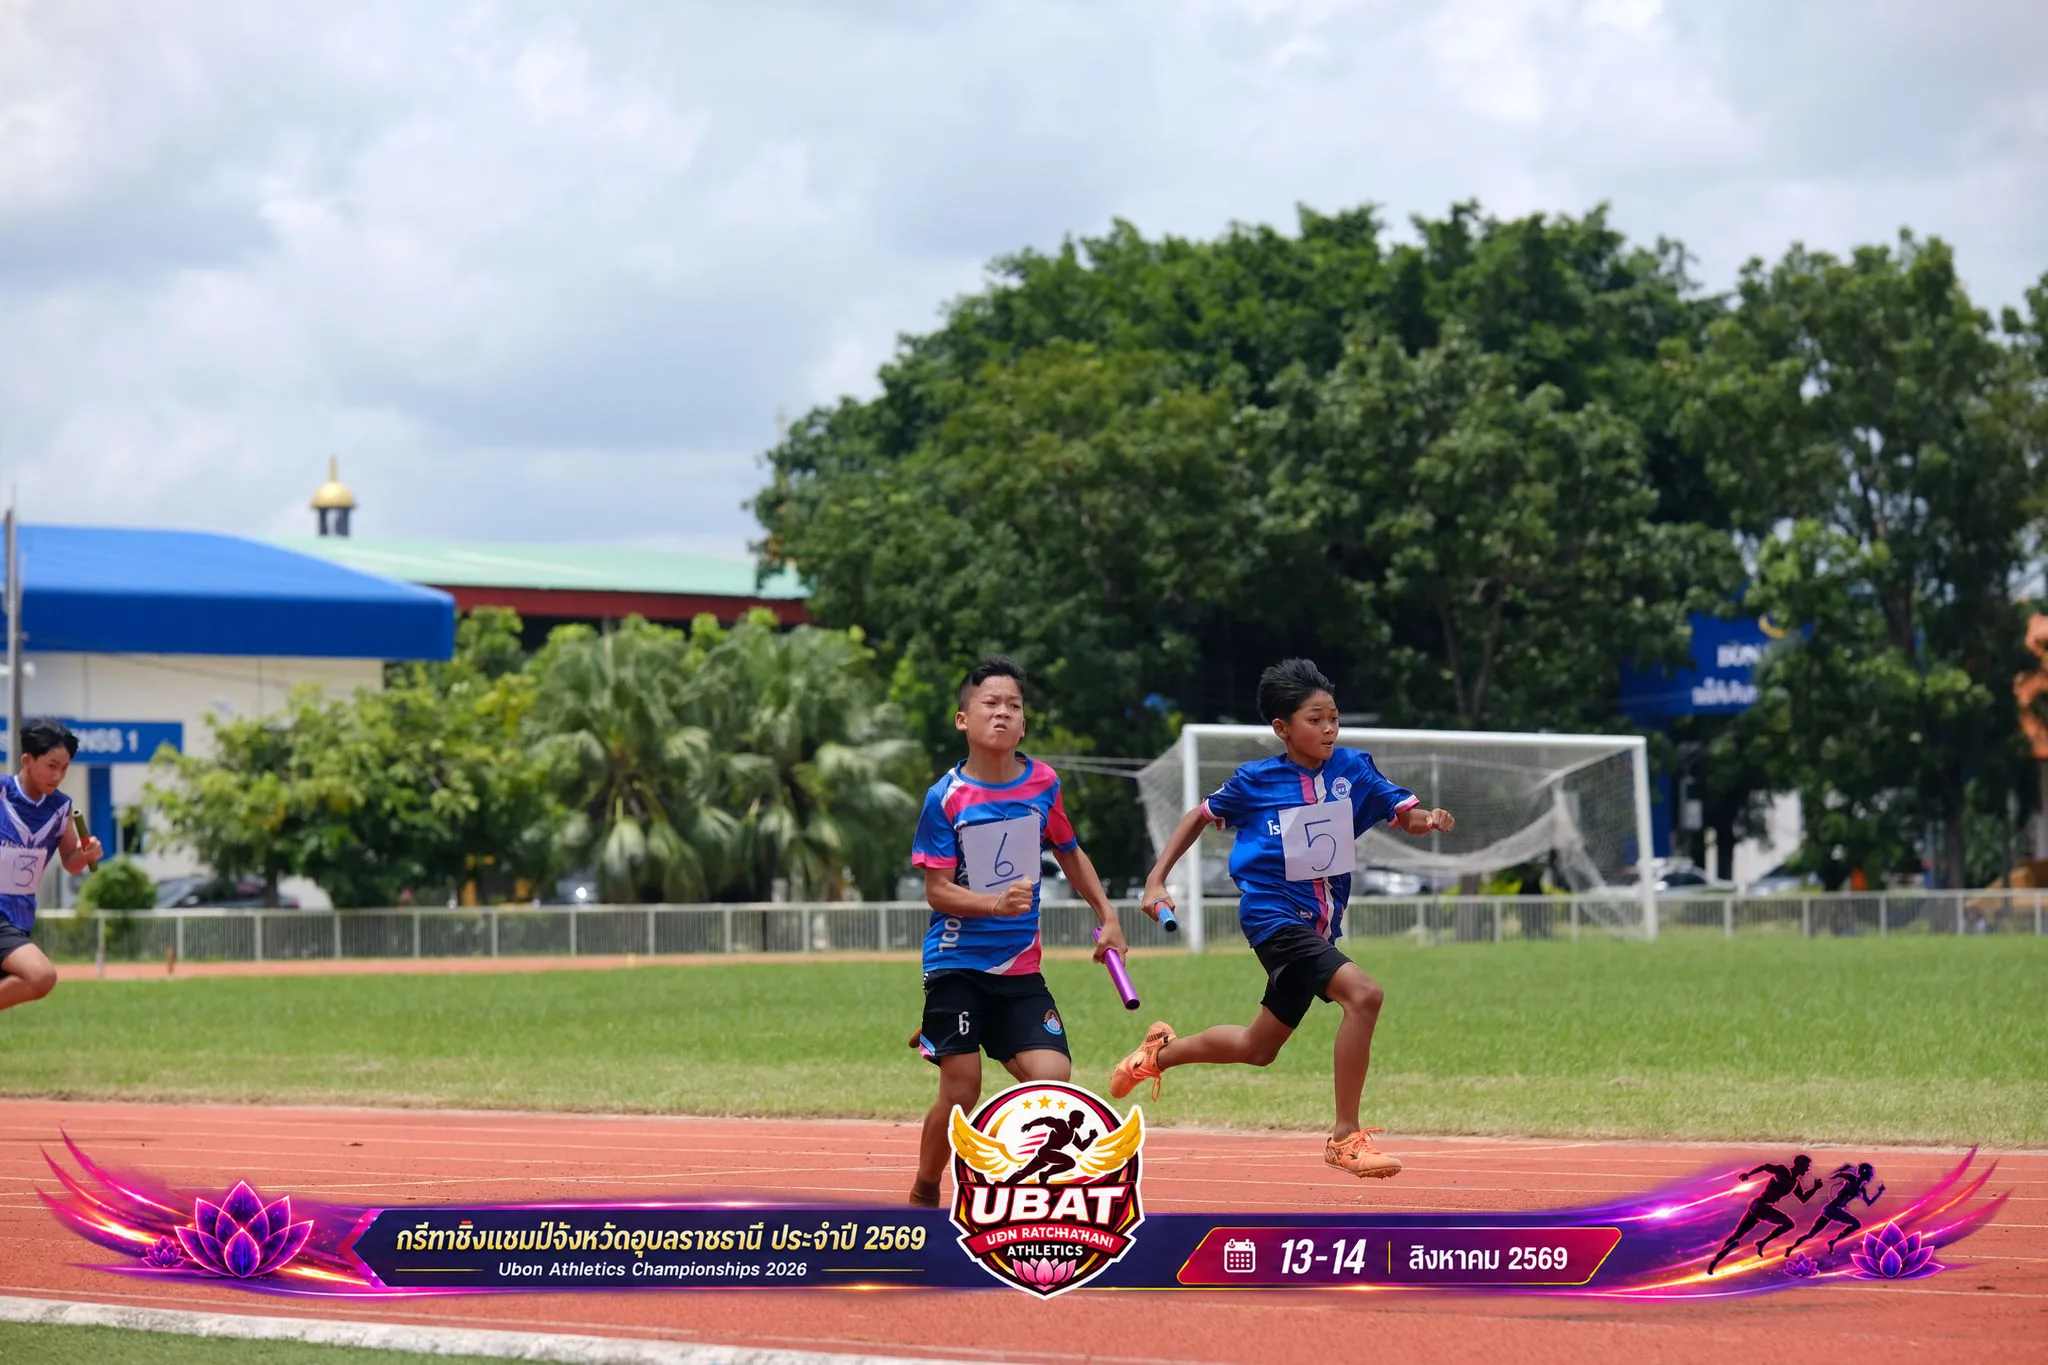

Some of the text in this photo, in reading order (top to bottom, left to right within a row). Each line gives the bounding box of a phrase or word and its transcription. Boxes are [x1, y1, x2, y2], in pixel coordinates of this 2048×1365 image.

[994, 832, 1014, 878] 6
[1304, 818, 1337, 872] 5
[16, 855, 38, 888] 3
[958, 1010, 971, 1036] 6
